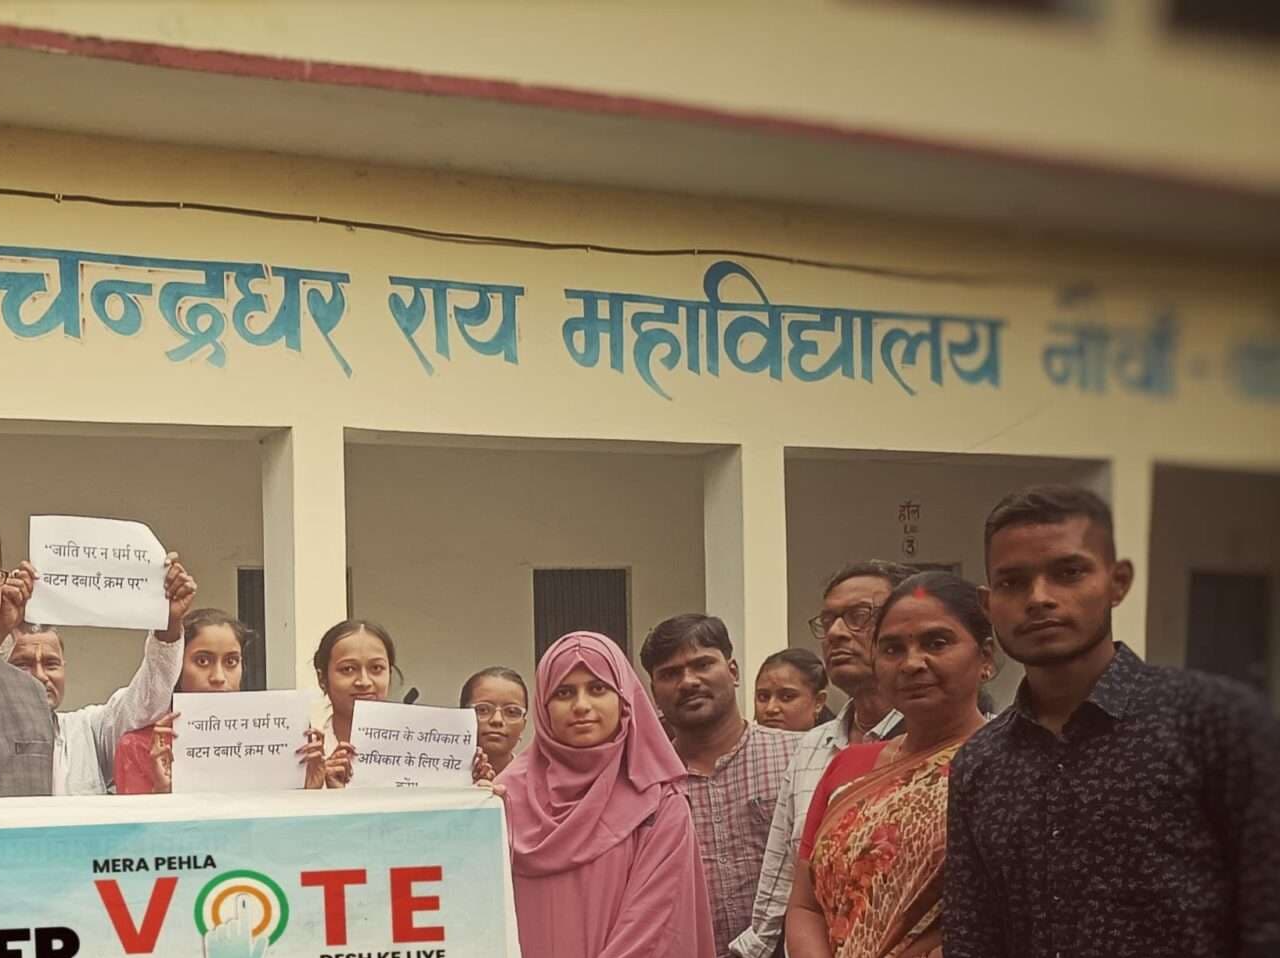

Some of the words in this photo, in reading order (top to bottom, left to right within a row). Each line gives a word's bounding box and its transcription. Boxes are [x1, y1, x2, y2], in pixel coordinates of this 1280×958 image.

[387, 275, 525, 376] राय
[561, 260, 1008, 400] महाविद्यालय
[83, 547, 97, 559] पर
[100, 549, 108, 560] न
[112, 543, 131, 561] धर्म
[43, 573, 68, 585] बटन
[104, 576, 124, 589] क्रम
[224, 719, 238, 730] पर
[240, 719, 248, 729] न
[253, 713, 270, 729] धर्म
[403, 726, 415, 741] के
[417, 728, 460, 745] अधिकार
[463, 730, 472, 745] से
[186, 747, 210, 759] बटन
[244, 744, 264, 756] क्रम
[358, 750, 401, 765] अधिकार
[404, 752, 416, 767] के
[418, 752, 440, 771] लिए
[443, 754, 464, 770] वोट
[92, 858, 150, 874] MERA
[154, 854, 217, 872] PEHLA
[94, 865, 446, 956] VOTE
